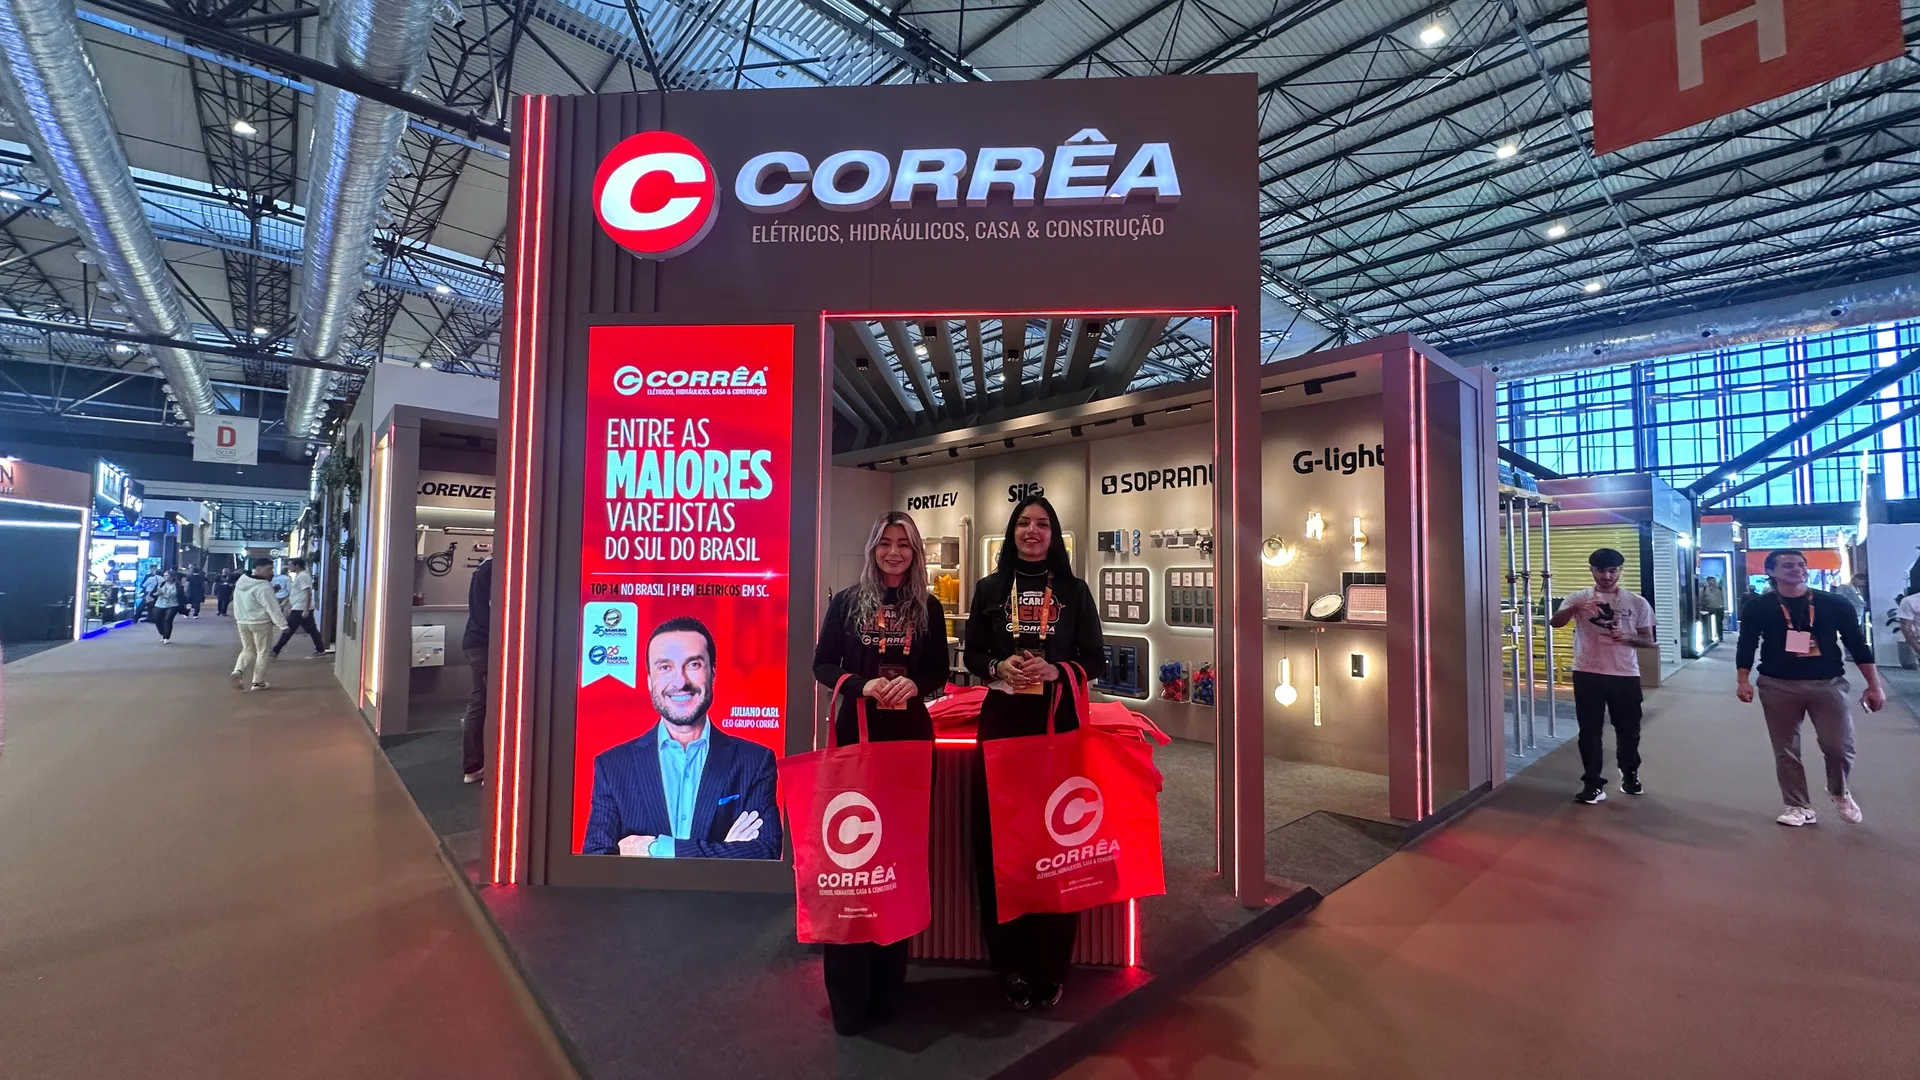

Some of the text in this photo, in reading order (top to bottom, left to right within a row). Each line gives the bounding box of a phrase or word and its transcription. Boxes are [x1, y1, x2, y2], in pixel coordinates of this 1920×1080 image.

[735, 128, 1181, 210] CORRÊA
[752, 214, 1164, 244] ELÉTRICOS, HIDRÁULICOS, CASA & CONSTRUÇÃO
[646, 366, 767, 387] CORRÊA
[217, 426, 236, 447] D
[607, 418, 710, 448] ENTRE AS
[1293, 443, 1384, 475] G-light
[605, 449, 773, 500] MAIORES
[417, 482, 495, 499] ORENZE
[907, 492, 958, 510] FORTLEV
[606, 502, 736, 532] VAREJISTAS
[605, 536, 760, 561] DO SUL DO BRASIL
[591, 583, 607, 595] TOP
[609, 584, 619, 595] 14
[621, 583, 633, 596] NO
[636, 584, 665, 596] BRASIL
[682, 584, 694, 596] EM
[696, 582, 740, 596] ELÉTRICOS
[742, 585, 754, 597] EM
[756, 585, 770, 597] SC.
[722, 719, 734, 728] CEO
[735, 719, 755, 728] GRUPO
[730, 706, 780, 717] JULIANO CARL
[1036, 839, 1120, 872] CORRÊA
[817, 865, 896, 888] CORRÊA
